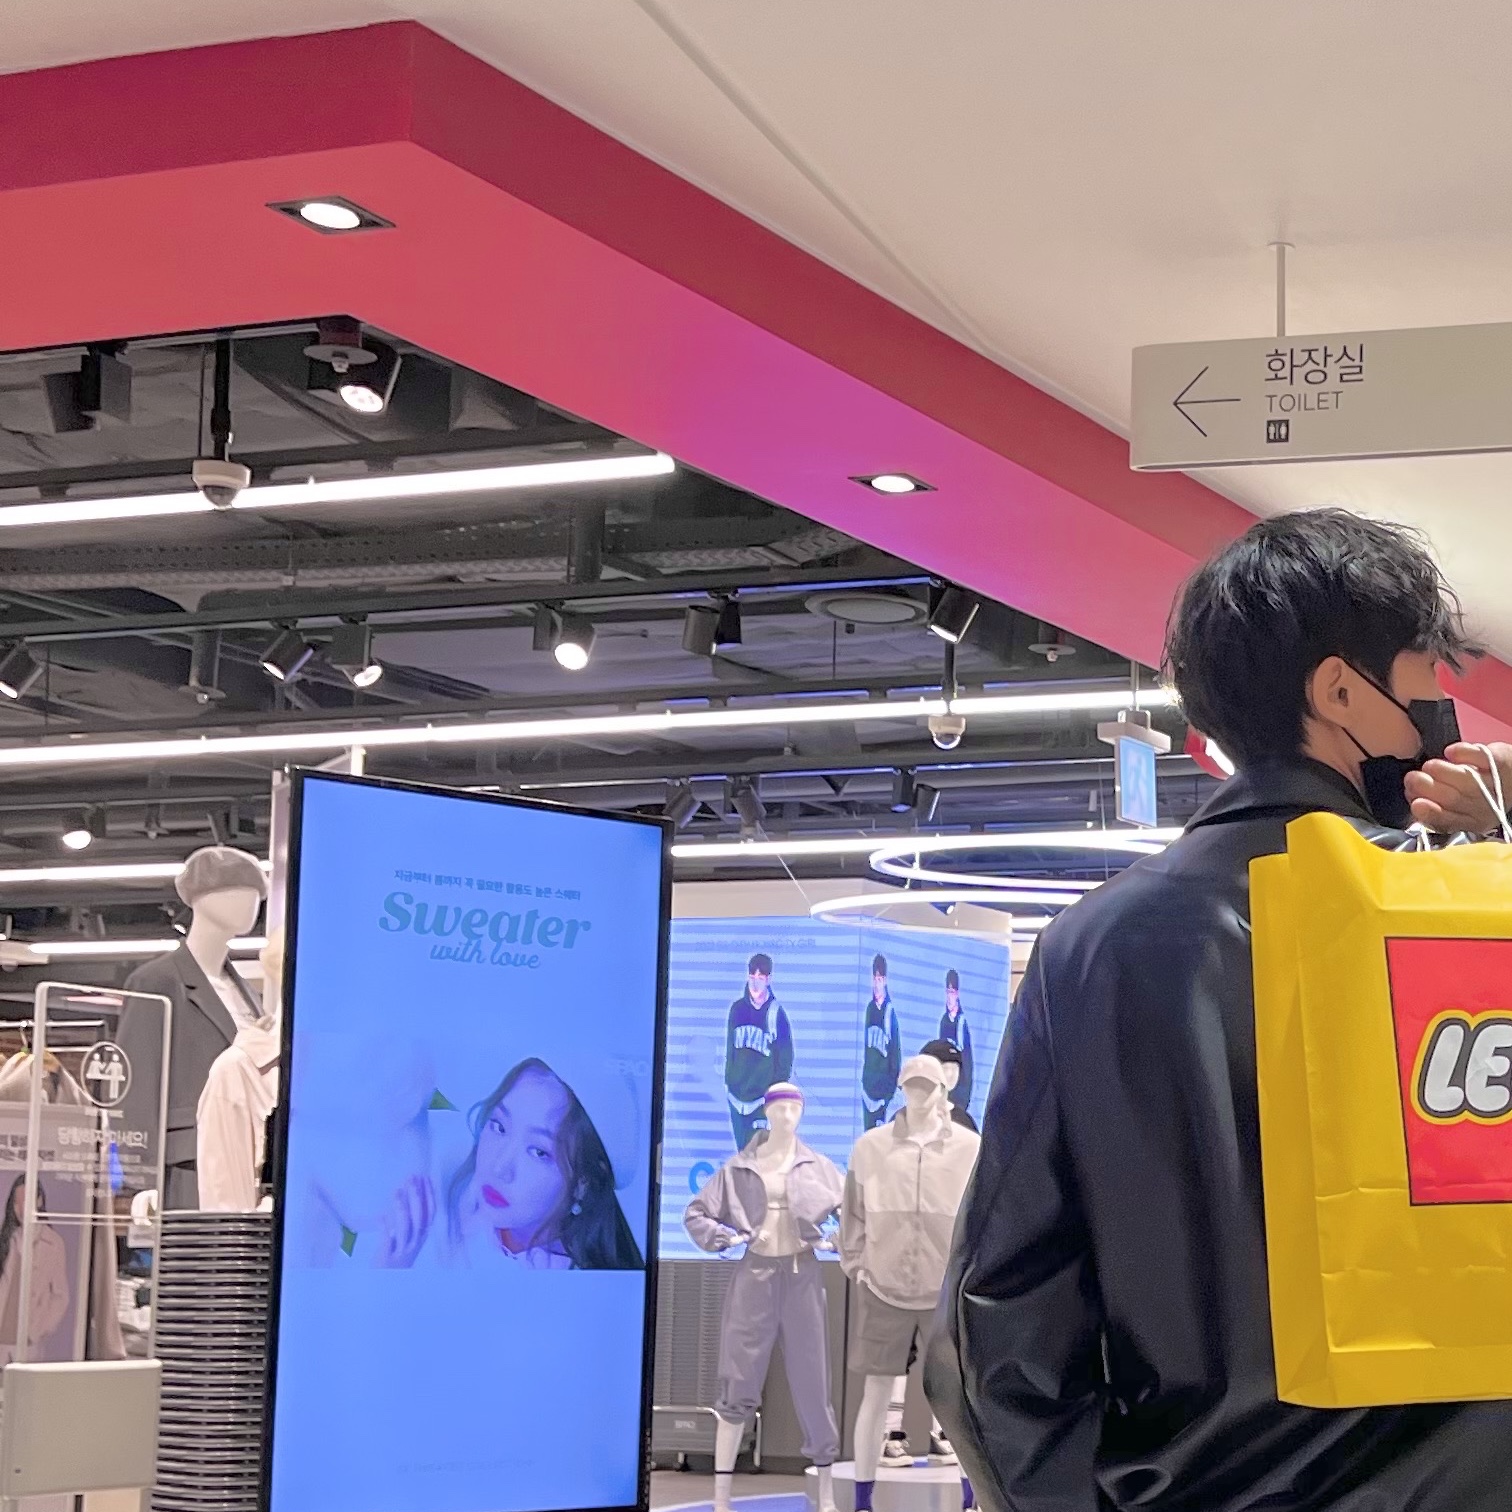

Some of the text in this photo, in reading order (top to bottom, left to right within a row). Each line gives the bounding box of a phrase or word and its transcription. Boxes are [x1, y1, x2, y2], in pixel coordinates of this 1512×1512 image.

[1264, 343, 1364, 386] 화장실
[1265, 390, 1344, 413] TOILET
[379, 891, 592, 949] Sweater
[429, 939, 542, 969] with love
